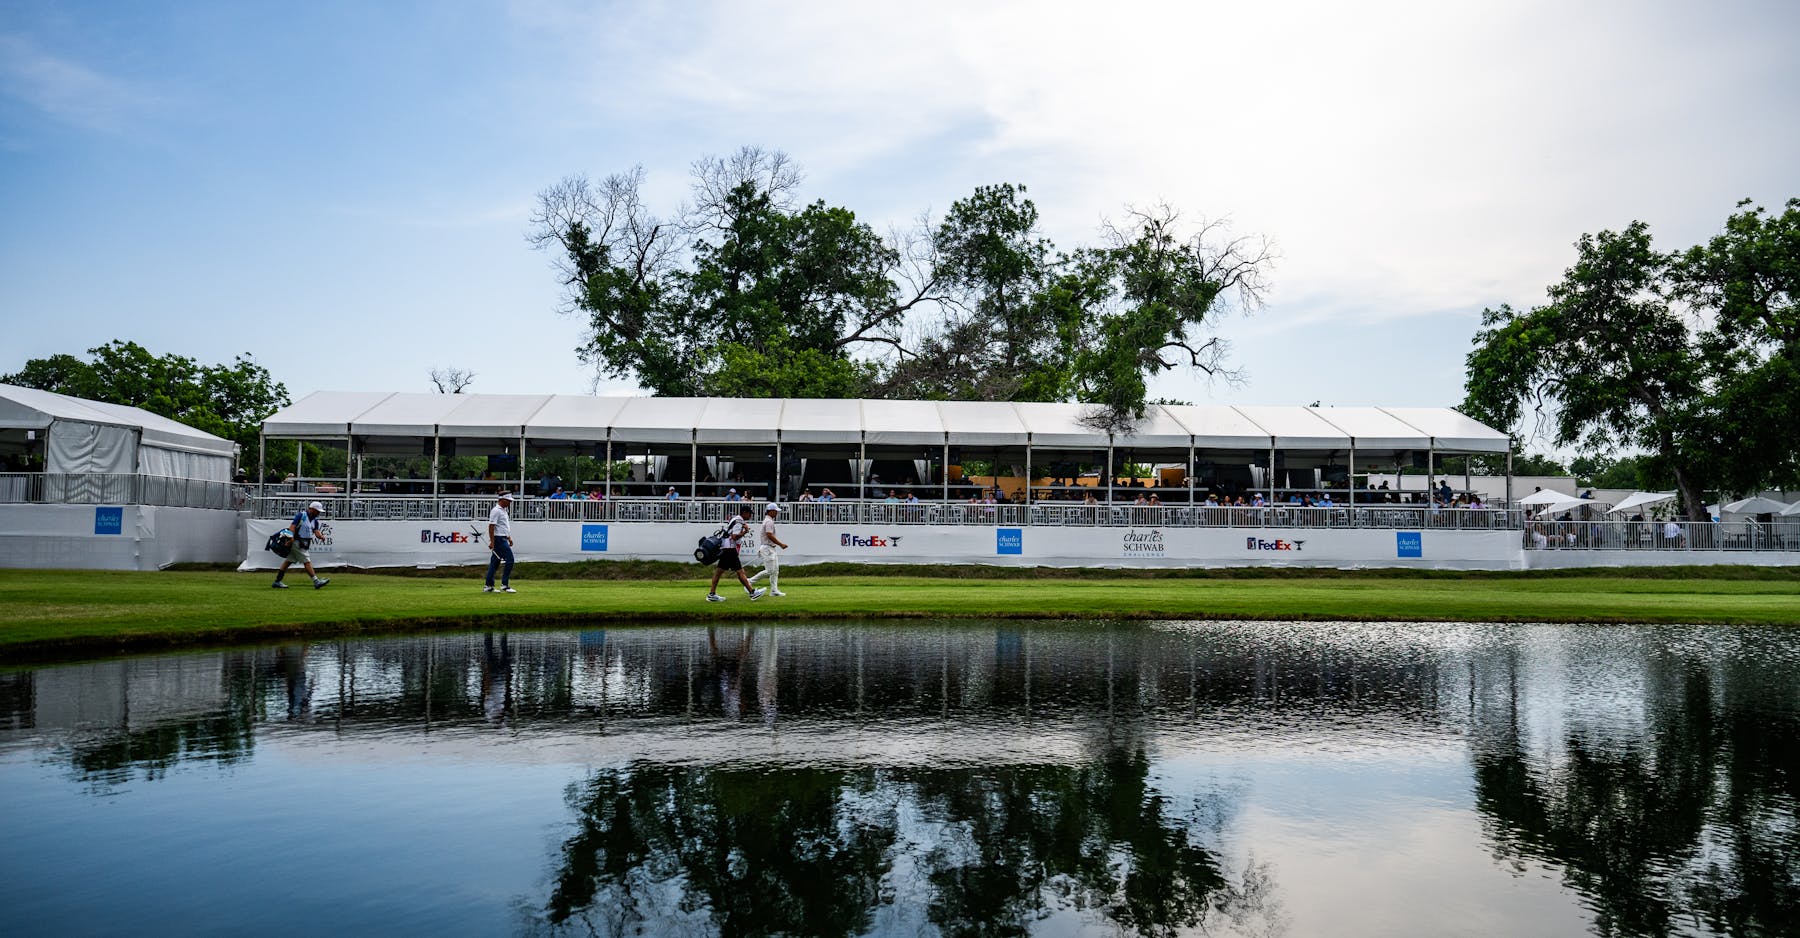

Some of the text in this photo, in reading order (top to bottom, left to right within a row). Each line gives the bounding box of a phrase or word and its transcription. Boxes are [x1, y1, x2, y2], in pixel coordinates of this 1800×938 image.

[432, 532, 468, 543] FedEx
[584, 531, 605, 539] charles
[1123, 529, 1164, 542] charles
[311, 538, 332, 546] WAB
[852, 536, 887, 546] FedEx
[1258, 540, 1292, 550] FedEx
[1123, 543, 1164, 552] SCHWAB
